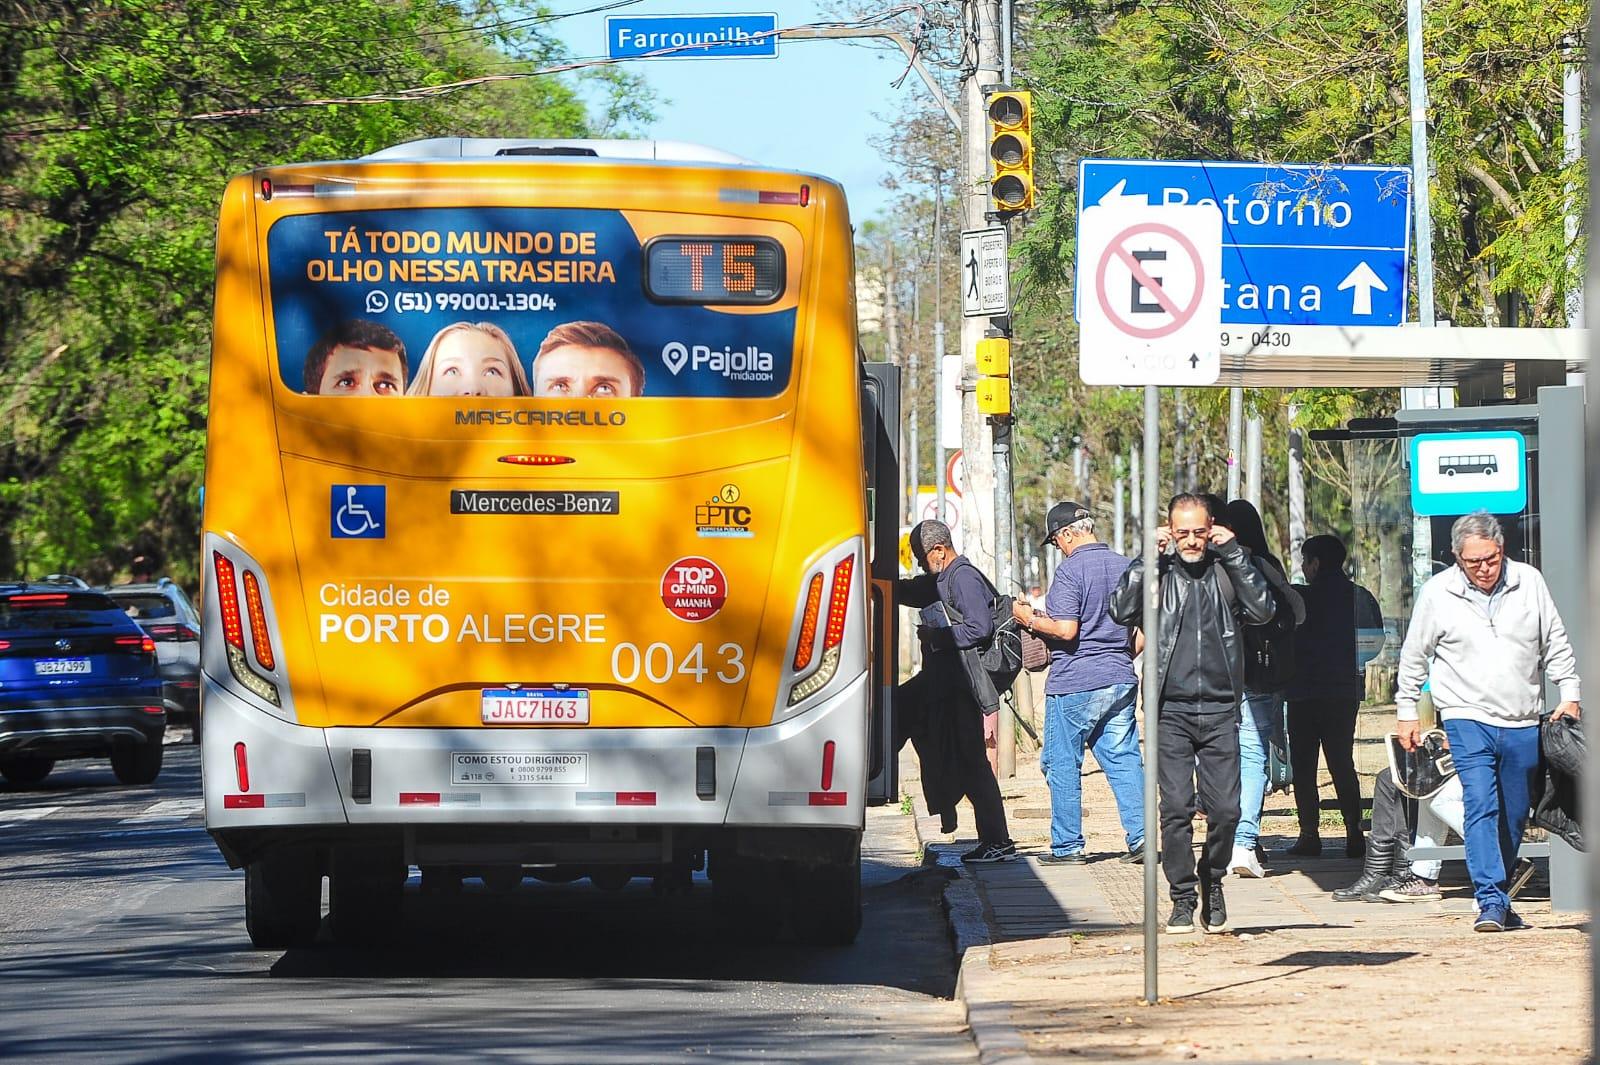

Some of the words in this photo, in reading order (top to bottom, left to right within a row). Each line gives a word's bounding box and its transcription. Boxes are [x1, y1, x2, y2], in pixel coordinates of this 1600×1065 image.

[618, 27, 765, 50] Farroupilha
[1163, 187, 1352, 228] Rtorno
[324, 226, 361, 254] TÁ
[365, 230, 441, 254] TODO
[446, 231, 554, 255] MUNDO
[559, 231, 597, 255] DE
[306, 259, 383, 282] OLHO
[389, 259, 480, 283] NESSA
[481, 260, 616, 284] TRASEIRA
[394, 290, 433, 313] (51)
[435, 292, 557, 312] 99001-1304
[1251, 331, 1291, 348] 0430
[692, 345, 774, 377] Pajolla
[455, 410, 626, 426] MASCARELLO
[459, 492, 612, 513] Mercedes-Benz
[695, 505, 752, 526] EPTC
[674, 566, 715, 585] TOP
[319, 583, 410, 607] Cidade
[418, 583, 450, 607] de
[670, 584, 686, 594] OF
[686, 584, 717, 595] MIND
[319, 613, 450, 643] PORTO
[456, 613, 607, 643] ALEGRE
[610, 642, 746, 684] 0043
[492, 700, 577, 719] JAC7H63
[458, 756, 488, 764] COMO
[490, 756, 522, 764] ESTOU
[524, 756, 582, 764] DIRIGINDO?
